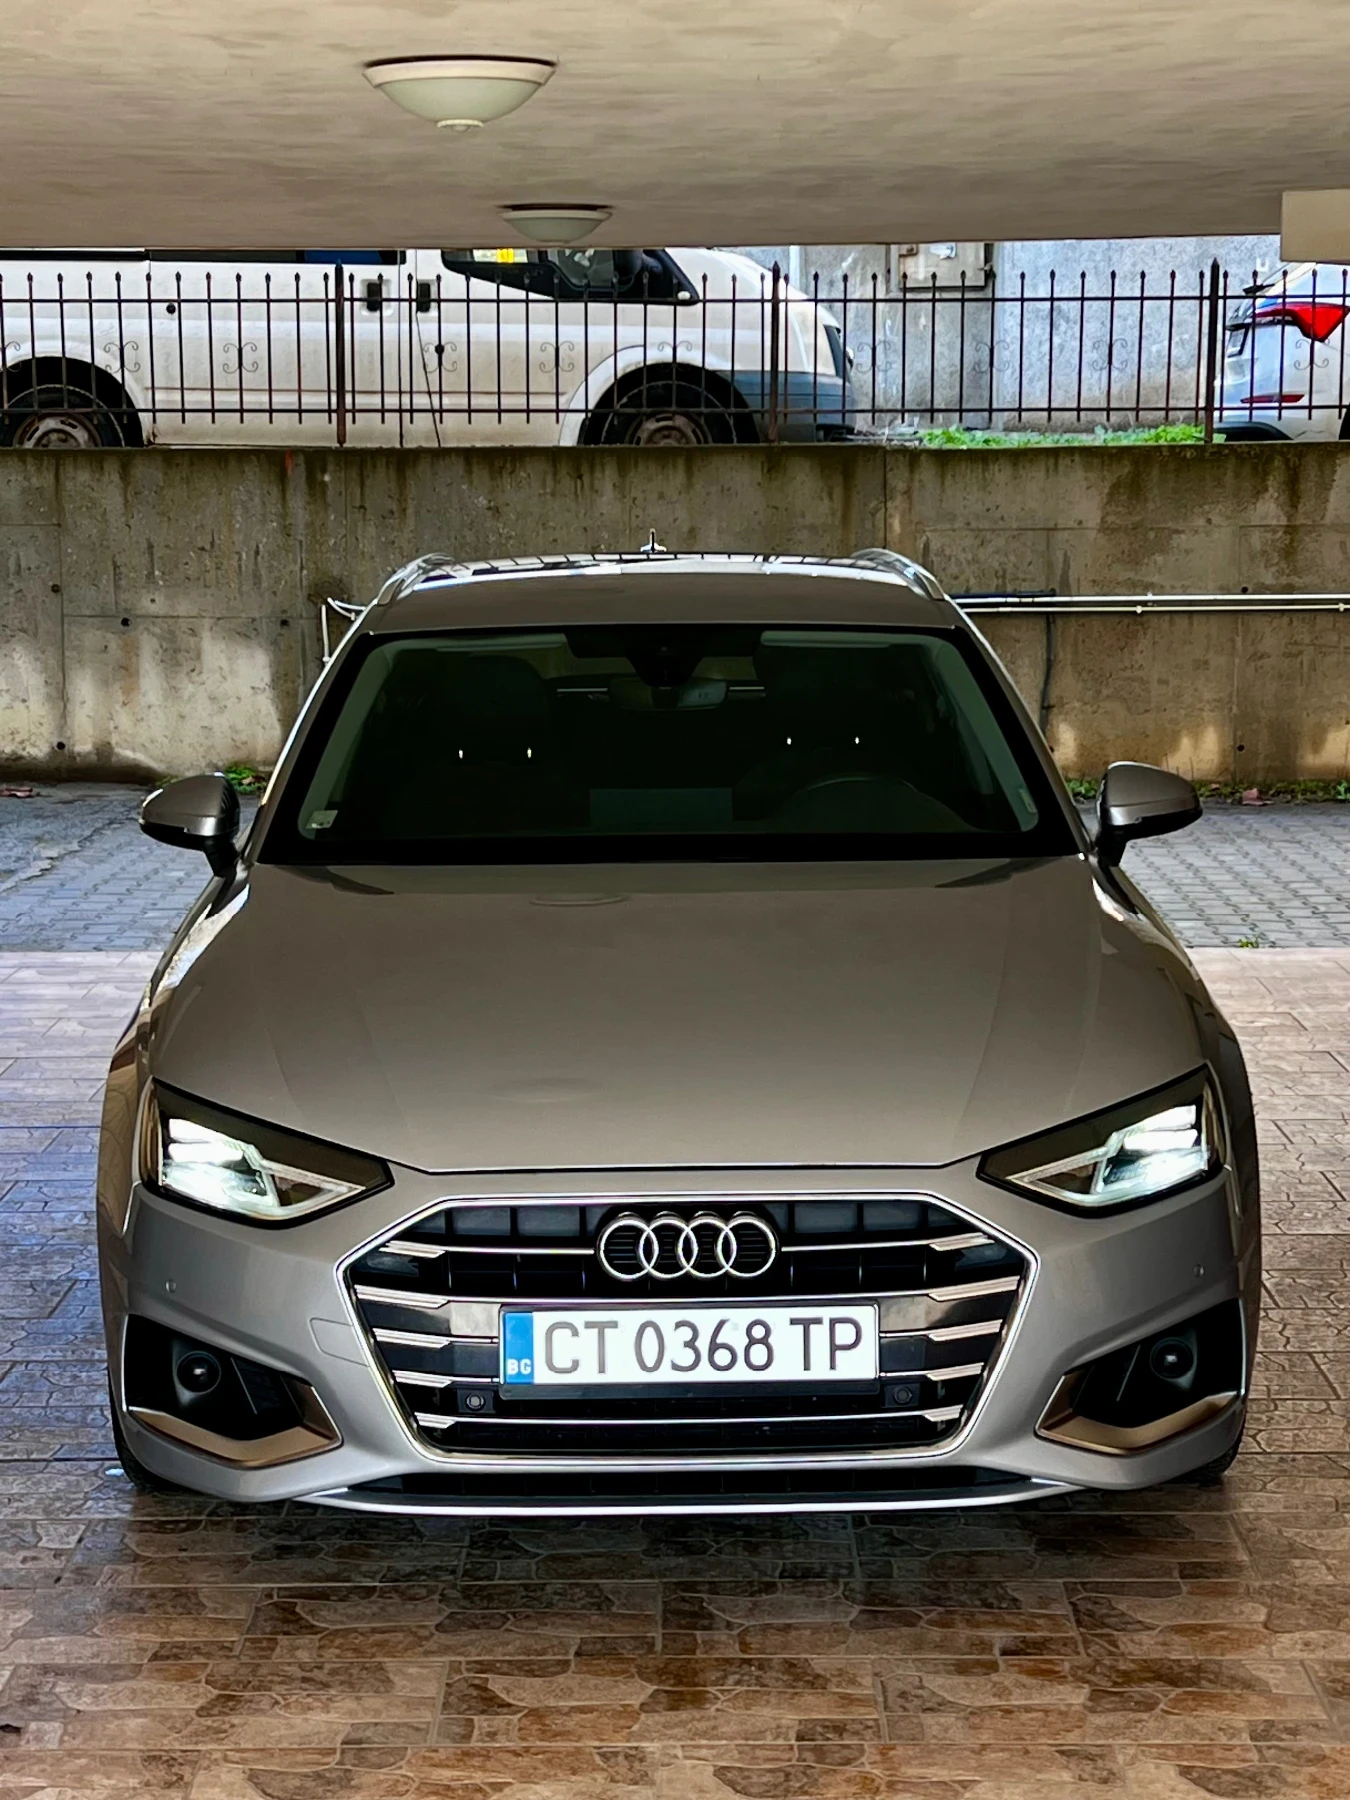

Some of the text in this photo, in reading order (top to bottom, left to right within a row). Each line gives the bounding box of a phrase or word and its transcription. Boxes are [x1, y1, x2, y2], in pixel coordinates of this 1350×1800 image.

[544, 1317, 863, 1374] CT 0368 TP
[507, 1358, 532, 1375] BG
